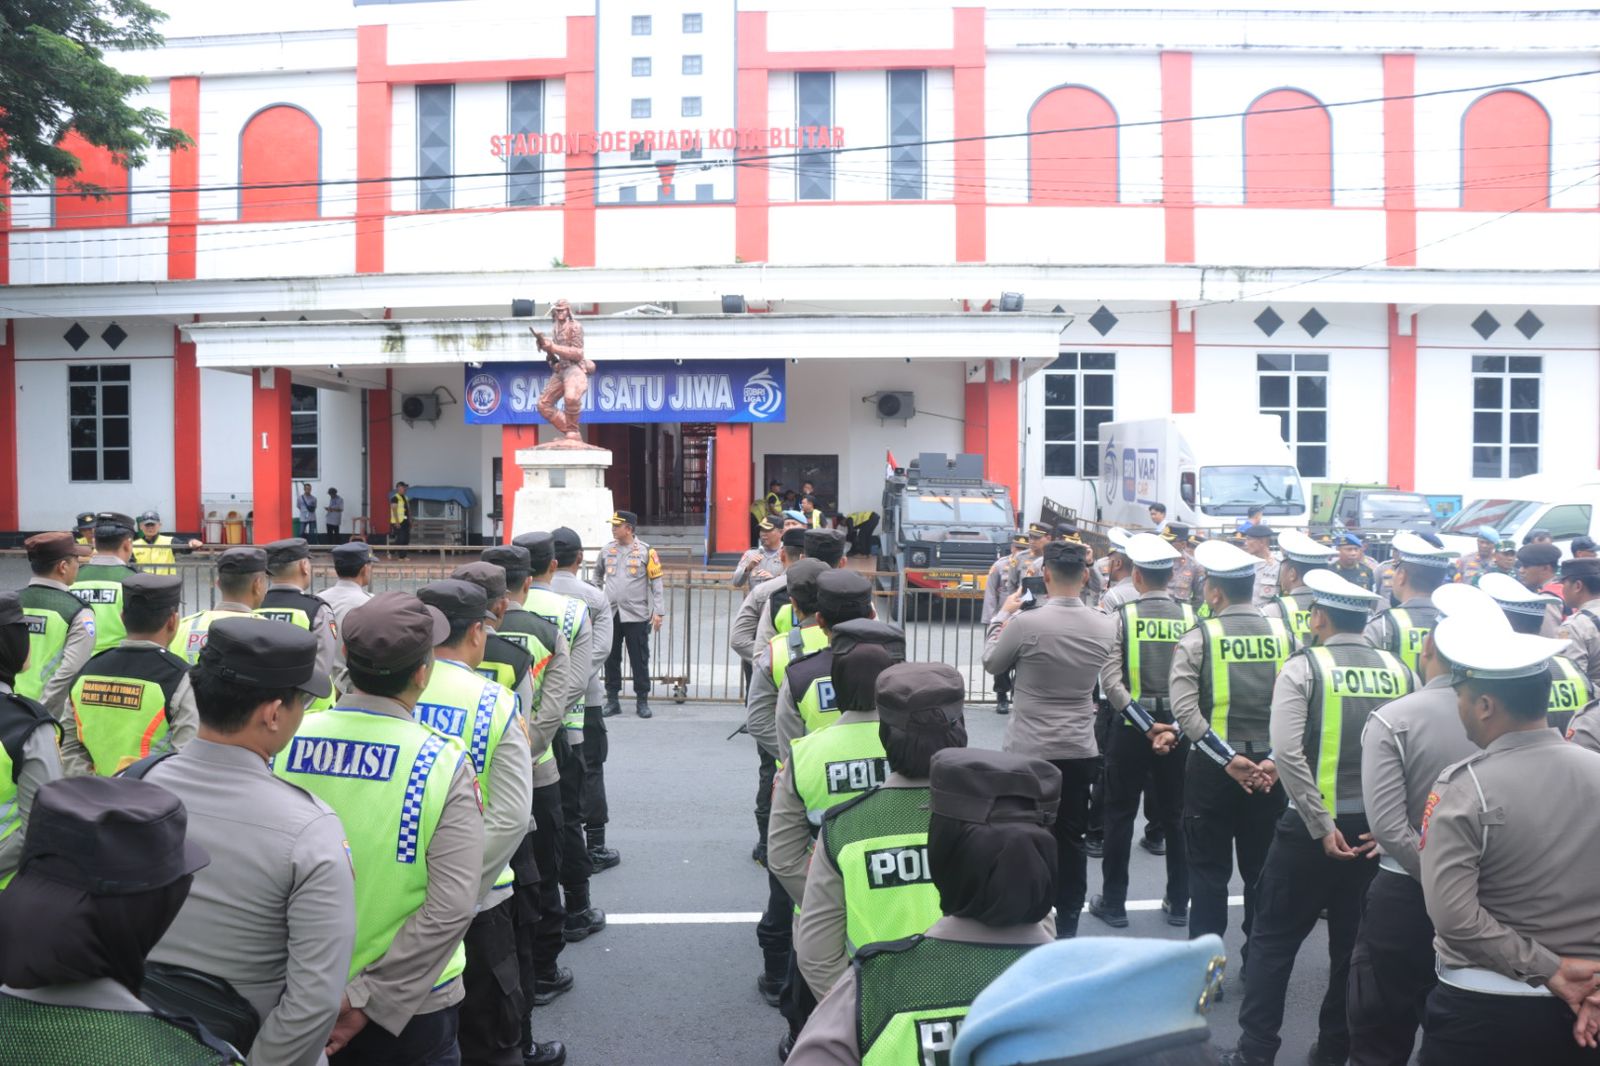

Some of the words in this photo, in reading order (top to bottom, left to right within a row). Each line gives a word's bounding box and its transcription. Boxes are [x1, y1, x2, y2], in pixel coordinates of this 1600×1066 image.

[489, 132, 580, 156] STADION
[591, 129, 701, 154] SOEPRIADI
[708, 128, 763, 150] KOTA
[769, 126, 845, 149] BLITAR
[510, 376, 594, 412] SAM
[598, 375, 664, 411] SATU
[669, 374, 735, 411] JIWA
[1138, 458, 1155, 480] VAR
[1220, 637, 1281, 660] POLISI
[1331, 669, 1399, 695] POLISI
[1549, 683, 1578, 707] ISI
[291, 739, 397, 779] POLISI
